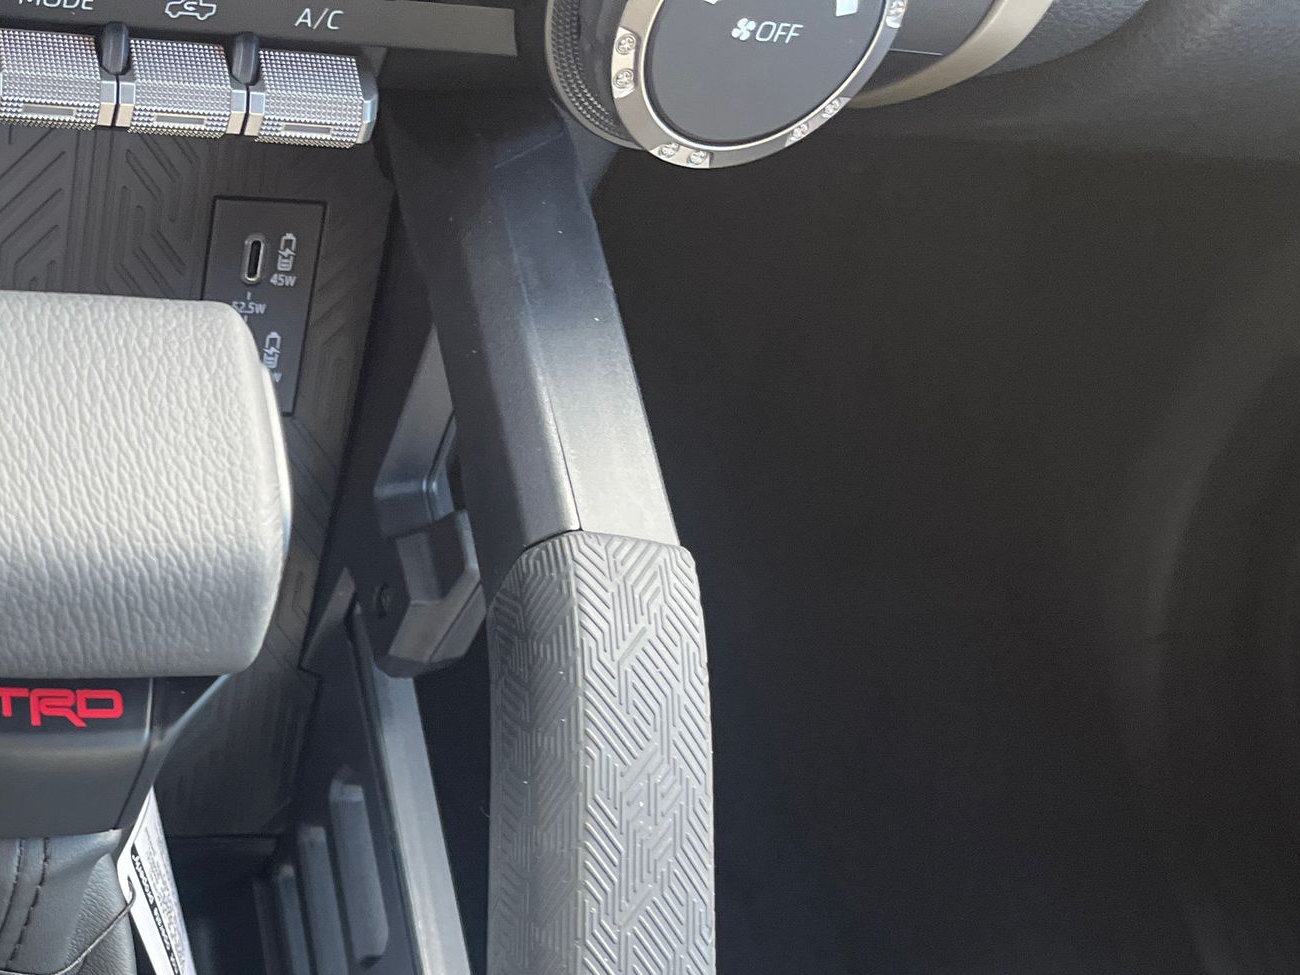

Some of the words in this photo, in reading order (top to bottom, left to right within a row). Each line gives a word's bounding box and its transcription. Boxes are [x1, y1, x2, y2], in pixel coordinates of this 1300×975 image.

[294, 8, 344, 30] A/C
[755, 21, 804, 43] OFF
[270, 273, 297, 287] 45W
